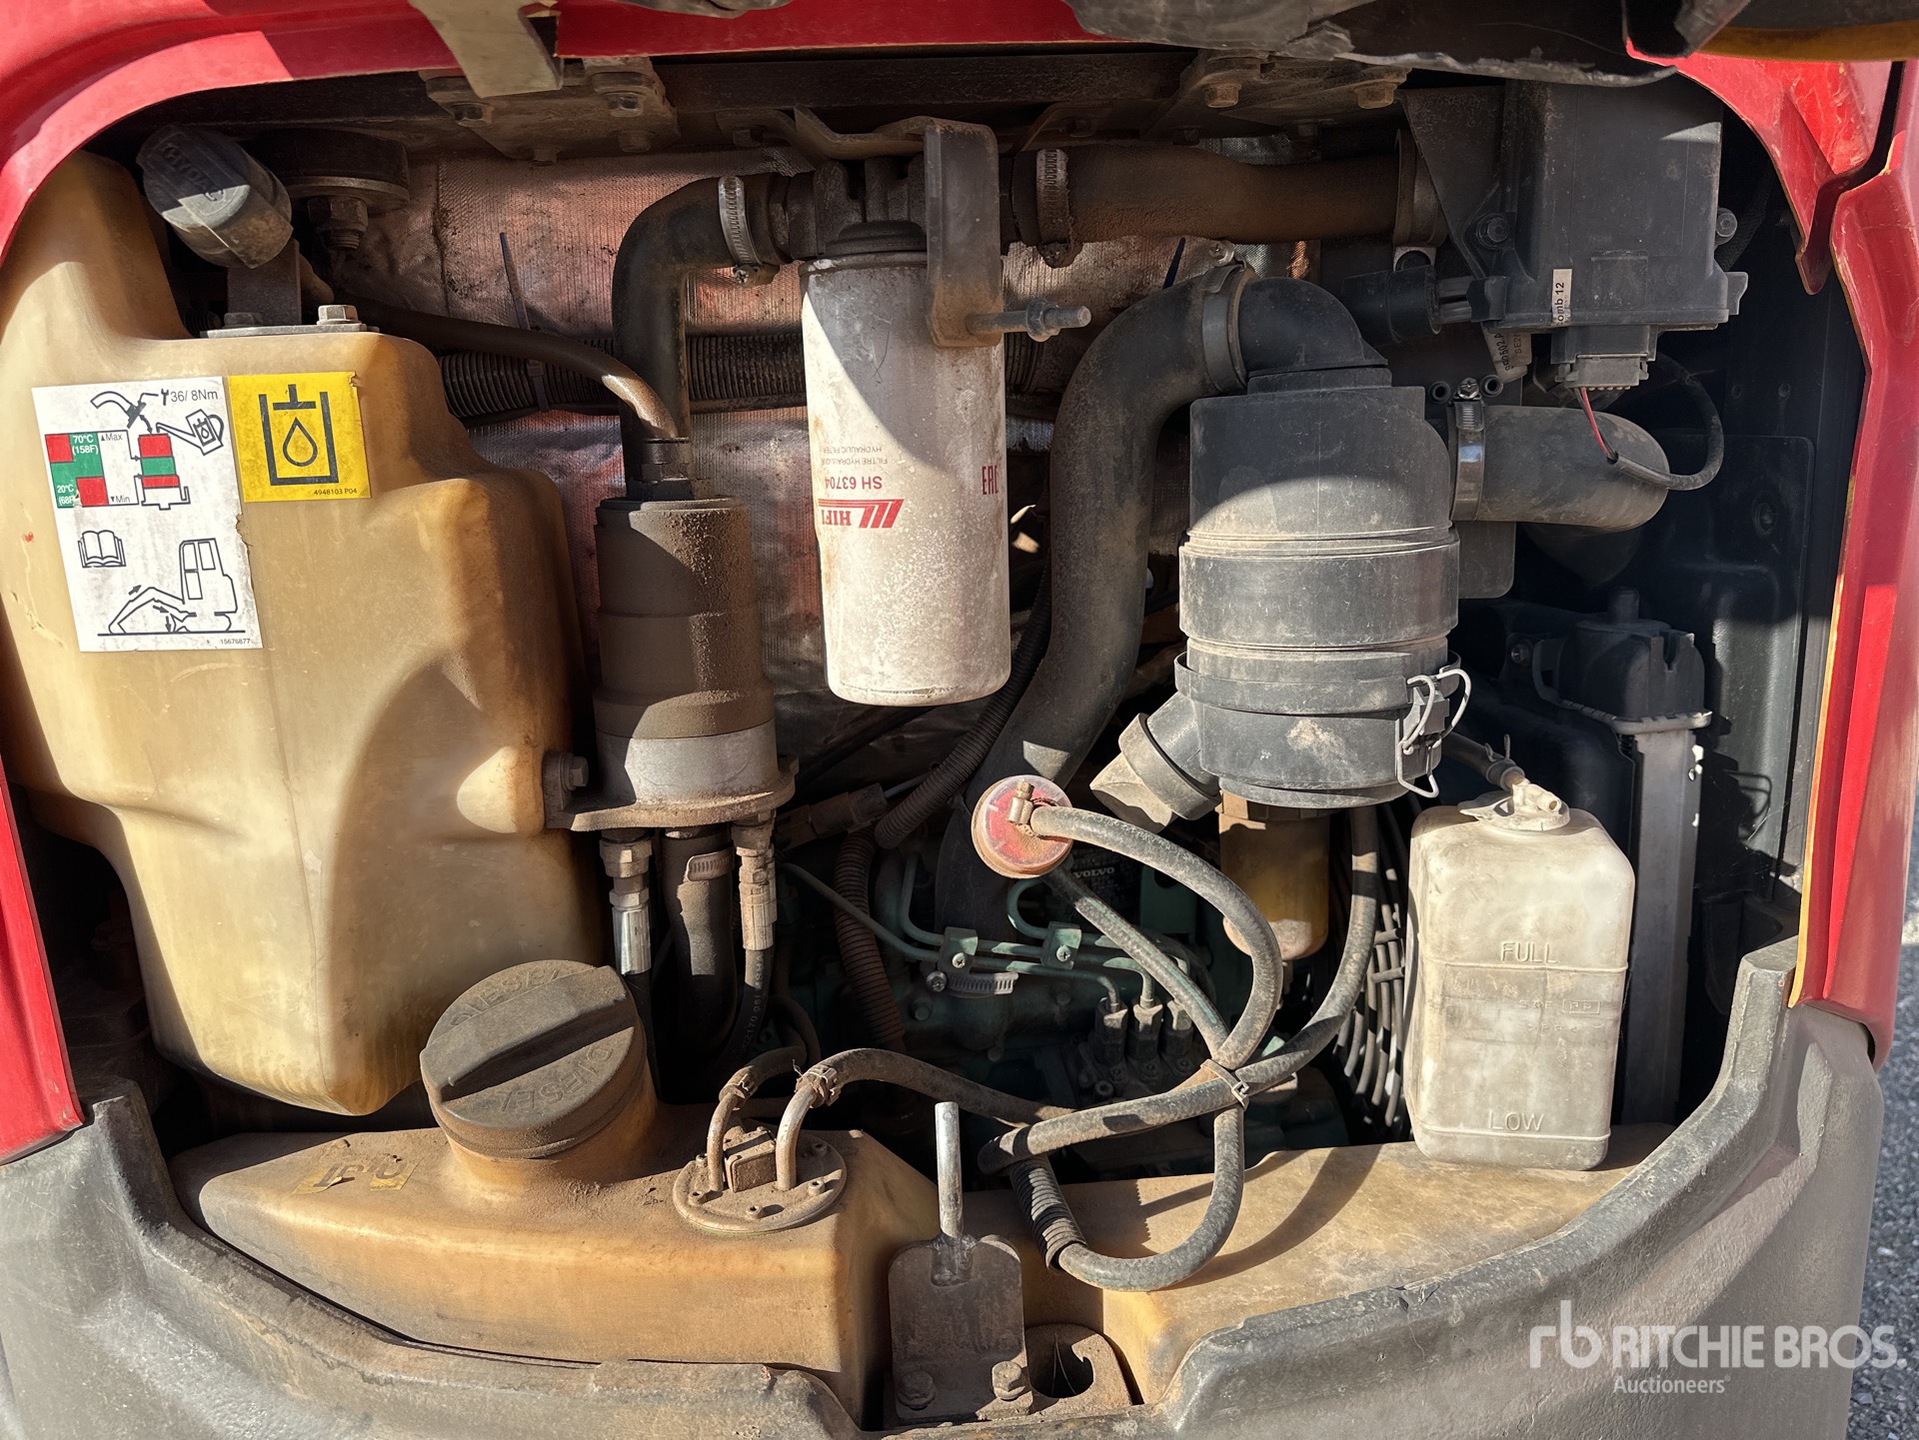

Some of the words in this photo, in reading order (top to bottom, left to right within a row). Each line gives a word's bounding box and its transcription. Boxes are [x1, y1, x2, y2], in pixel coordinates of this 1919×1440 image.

[1555, 282, 1565, 295] 12
[191, 389, 218, 401] 8Nm
[73, 435, 94, 444] 70°C
[105, 433, 123, 441] Max
[72, 444, 99, 456] (158F)
[57, 484, 75, 493] 20°C
[825, 476, 857, 490] 63704
[862, 475, 882, 490] SH
[115, 495, 131, 503] Min
[1073, 866, 1115, 878] VOLVO
[1500, 941, 1558, 964] FULL
[1487, 1110, 1545, 1132] LOW
